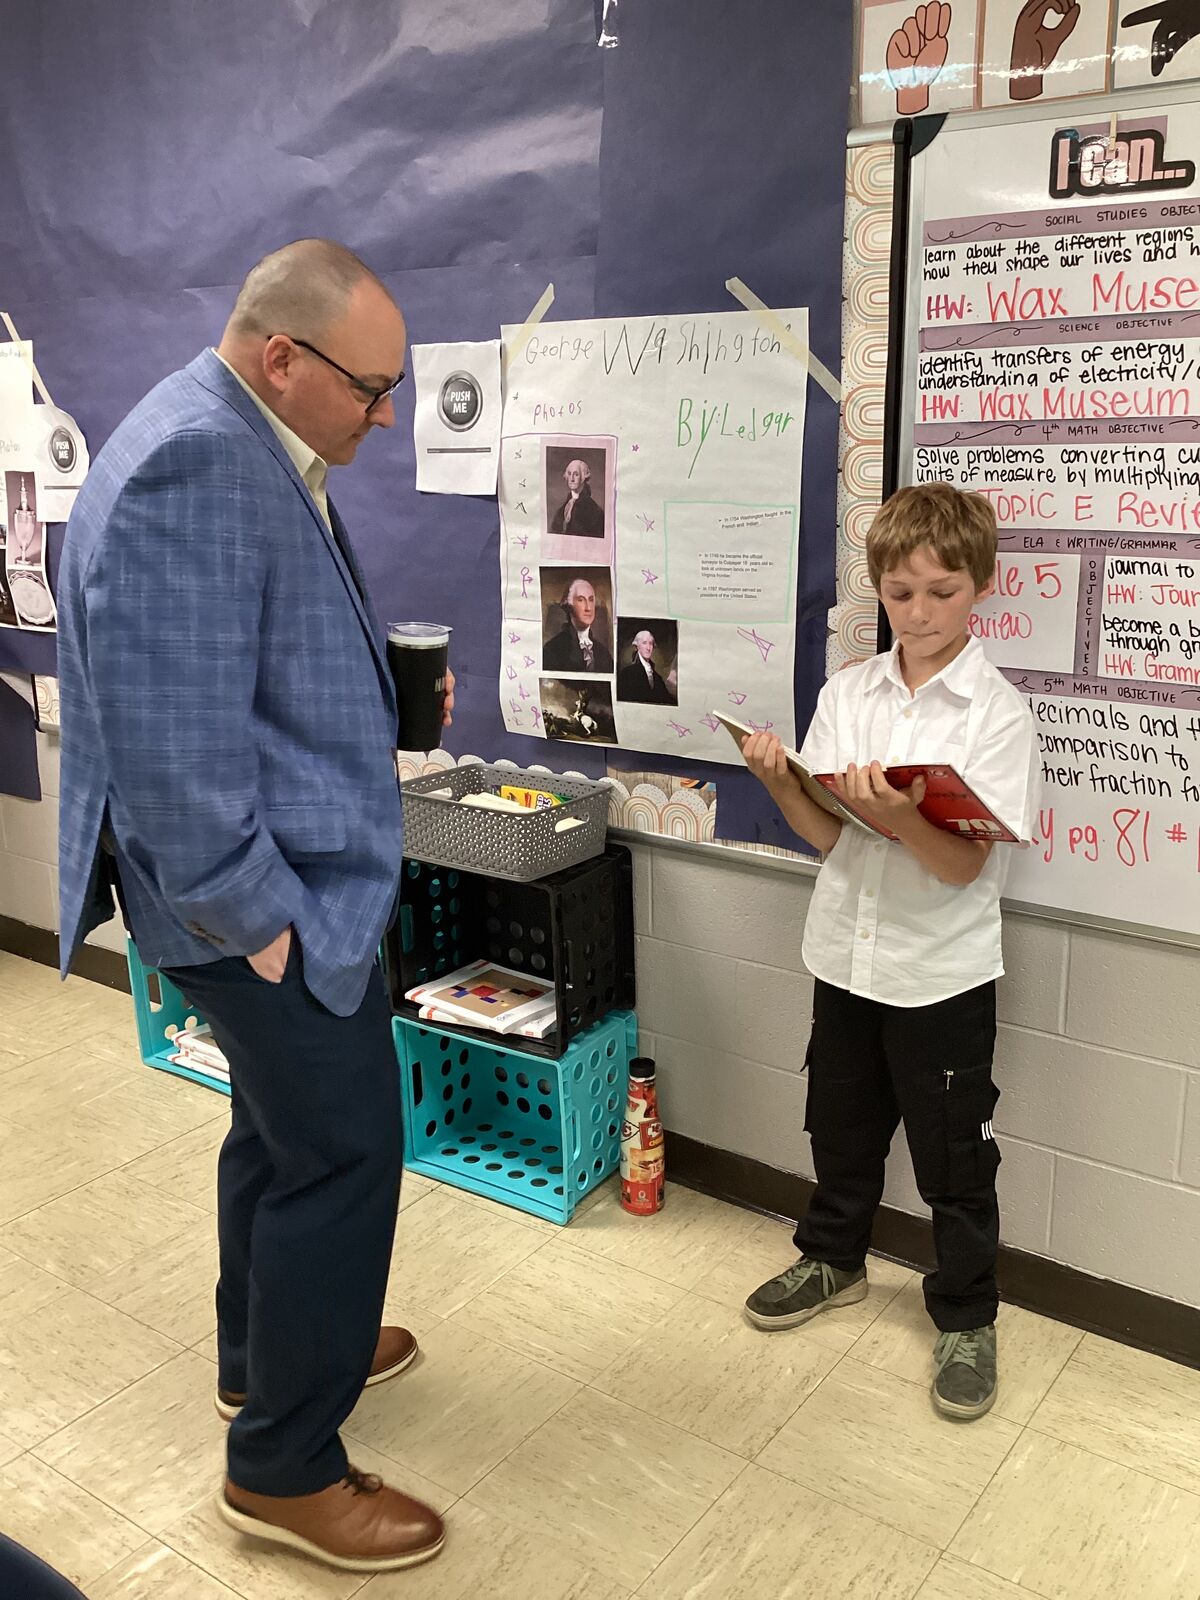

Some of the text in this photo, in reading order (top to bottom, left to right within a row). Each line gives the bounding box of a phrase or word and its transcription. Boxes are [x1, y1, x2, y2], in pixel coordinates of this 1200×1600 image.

[1057, 138, 1070, 190] I
[1045, 215, 1082, 227] SOCIAL
[1097, 208, 1147, 221] STUDIES
[924, 227, 1194, 265] learn about the different regions
[924, 266, 950, 280] how
[963, 261, 997, 276] they
[1006, 254, 1049, 272] shape
[1060, 254, 1084, 268] our
[1094, 248, 1132, 264] lives
[1143, 243, 1177, 262] and
[926, 294, 973, 320] HW:
[987, 276, 1068, 322] Wax
[1059, 318, 1173, 333] SCIENCE OBJECTIVE
[526, 336, 594, 365] George
[920, 342, 1185, 377] identify transfers of energy
[918, 370, 1038, 390] understanding
[1049, 367, 1069, 382] of
[450, 390, 471, 402] PUSH
[453, 402, 468, 414] ME
[922, 386, 1190, 421] HW: Wax Museum
[1068, 425, 1098, 436] MATH
[1108, 423, 1165, 434] OBJECTIVE
[917, 448, 960, 467] Solve
[967, 446, 1045, 469] problems
[1060, 445, 1165, 473] converting
[916, 466, 954, 483] units
[960, 467, 980, 483] of
[984, 468, 1057, 483] measure
[1067, 466, 1086, 487] by
[1075, 495, 1094, 521] E
[1023, 536, 1044, 548] ELA
[1034, 562, 1062, 598] 5
[1107, 558, 1195, 579] journal to
[1107, 584, 1143, 604] HW:
[967, 611, 1032, 640] eview
[1082, 560, 1097, 676] OBJECTIVES
[1102, 613, 1163, 635] become
[1169, 623, 1181, 637] a
[1106, 632, 1170, 657] through
[1044, 678, 1177, 703] 5th MATH OBJECTIVE
[1139, 714, 1178, 738] and
[1164, 744, 1189, 771] to
[1089, 763, 1172, 798] fraction
[1113, 808, 1151, 867] 81
